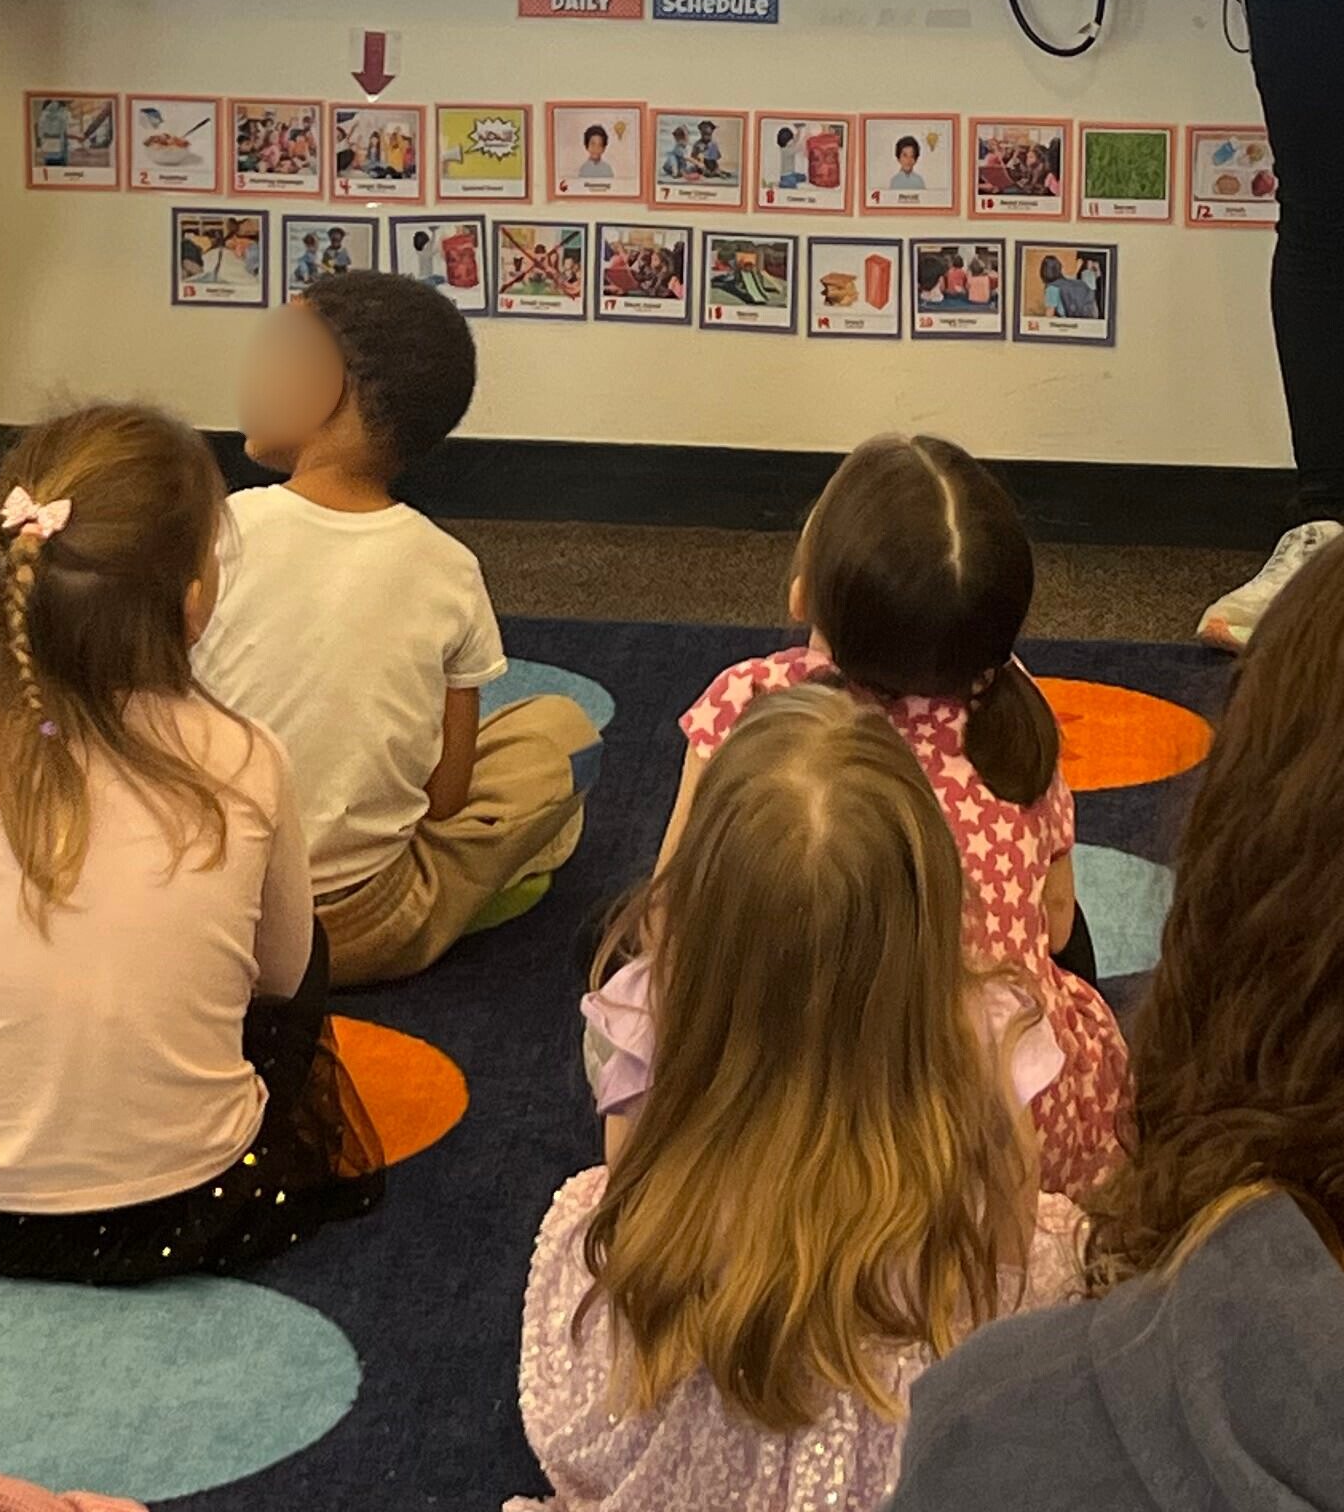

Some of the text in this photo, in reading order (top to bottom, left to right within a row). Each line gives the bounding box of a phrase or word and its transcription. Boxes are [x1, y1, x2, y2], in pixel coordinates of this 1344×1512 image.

[43, 167, 49, 181] 1
[139, 171, 151, 185] 2
[238, 174, 246, 188] 3
[339, 178, 352, 195] 4
[558, 178, 568, 193] 6
[660, 187, 670, 200] 7
[871, 190, 881, 204] 9
[1196, 204, 1213, 219] 12
